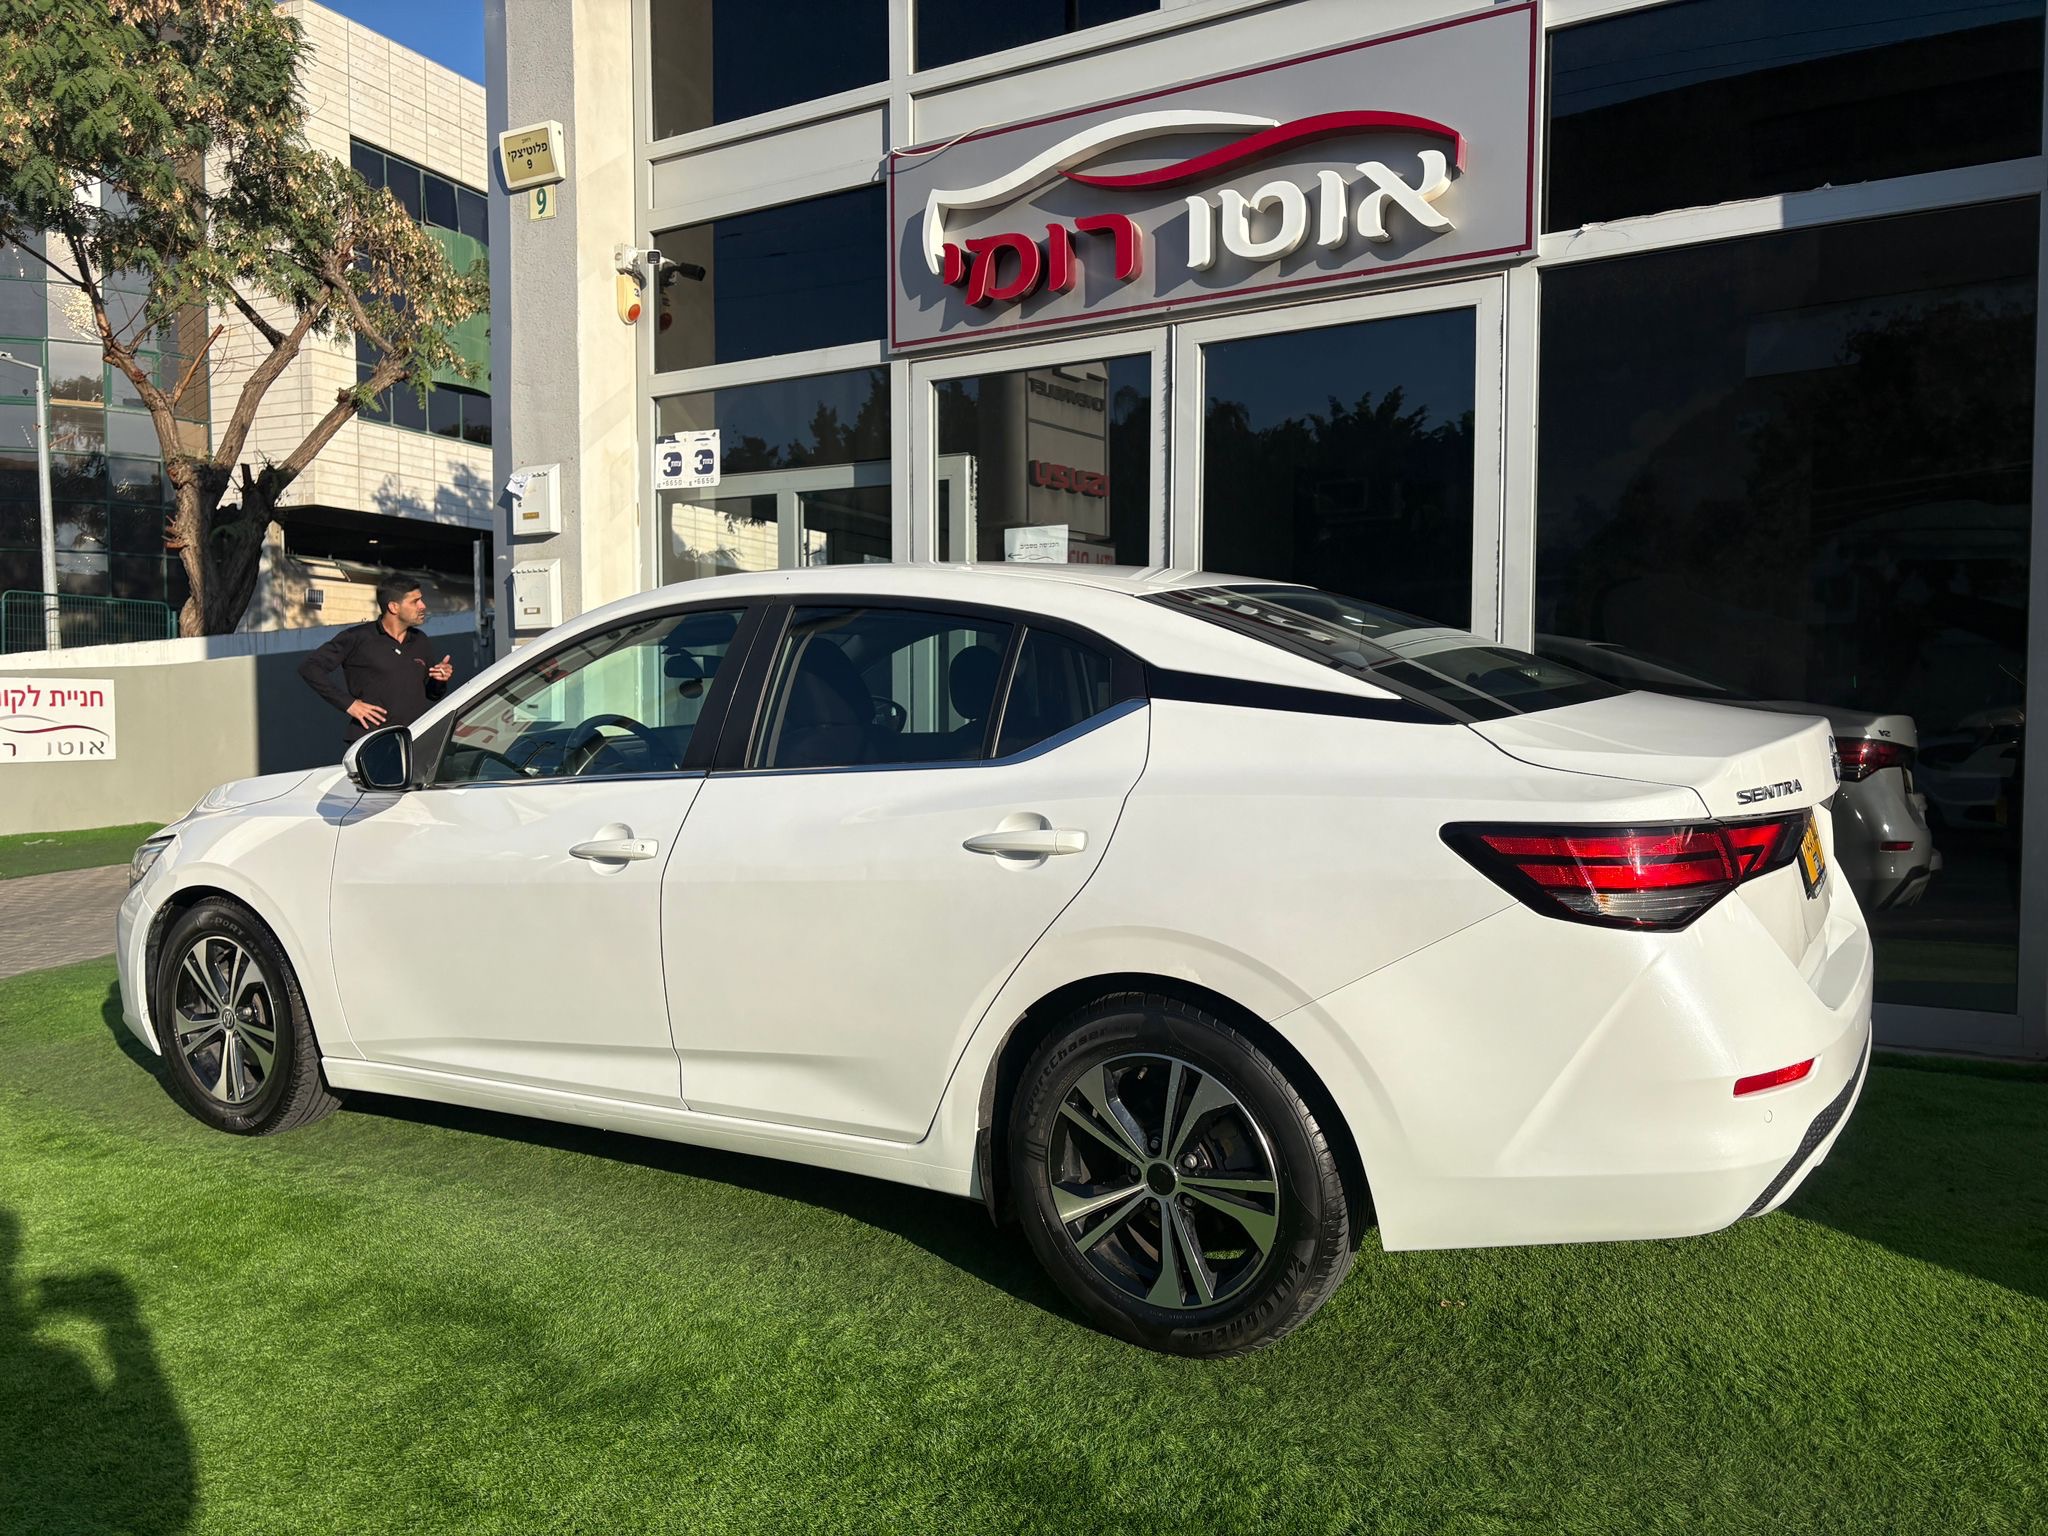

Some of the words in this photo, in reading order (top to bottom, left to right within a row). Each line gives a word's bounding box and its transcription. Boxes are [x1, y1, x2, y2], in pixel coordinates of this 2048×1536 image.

[507, 142, 548, 163] פלוטיצקי
[527, 159, 533, 169] 9
[536, 188, 547, 215] 9
[1185, 148, 1457, 271] אוטו
[942, 212, 1142, 309] רומי
[0, 684, 41, 714] לקו
[49, 690, 103, 707] חניית
[47, 740, 105, 756] אוטו
[1735, 778, 1803, 805] SENTRA
